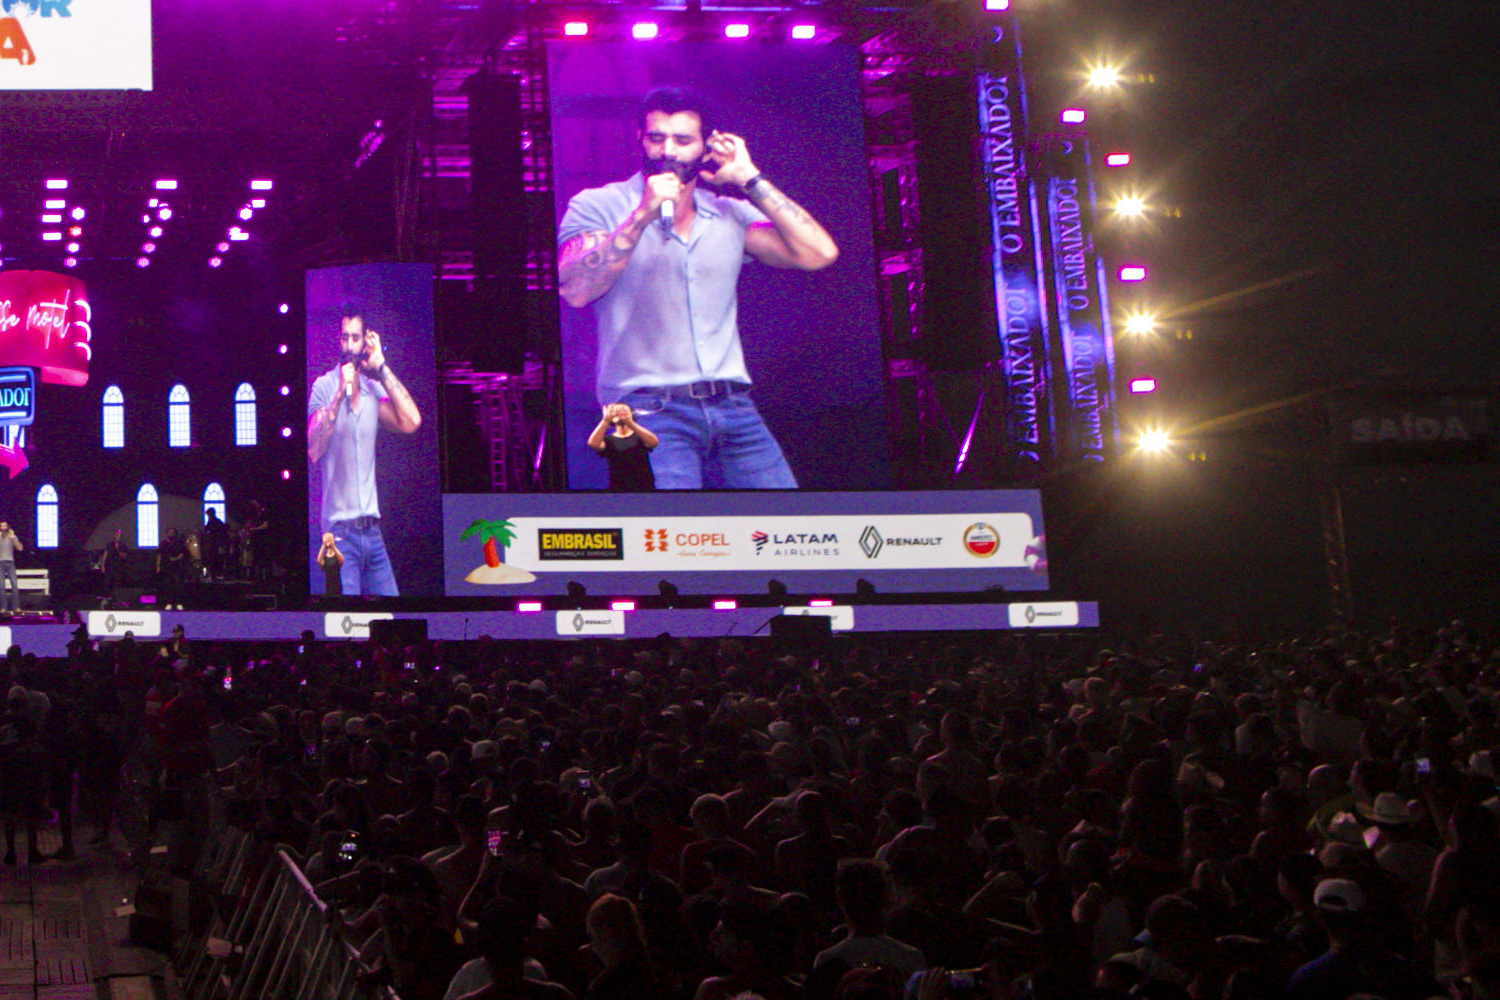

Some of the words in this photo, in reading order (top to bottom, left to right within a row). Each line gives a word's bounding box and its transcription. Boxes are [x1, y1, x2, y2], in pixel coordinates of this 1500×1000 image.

[541, 533, 617, 549] EMBRASIL
[676, 533, 730, 546] COPEL
[773, 534, 838, 544] LATAM
[886, 537, 943, 546] RENAULT
[775, 548, 840, 556] AIRLINES
